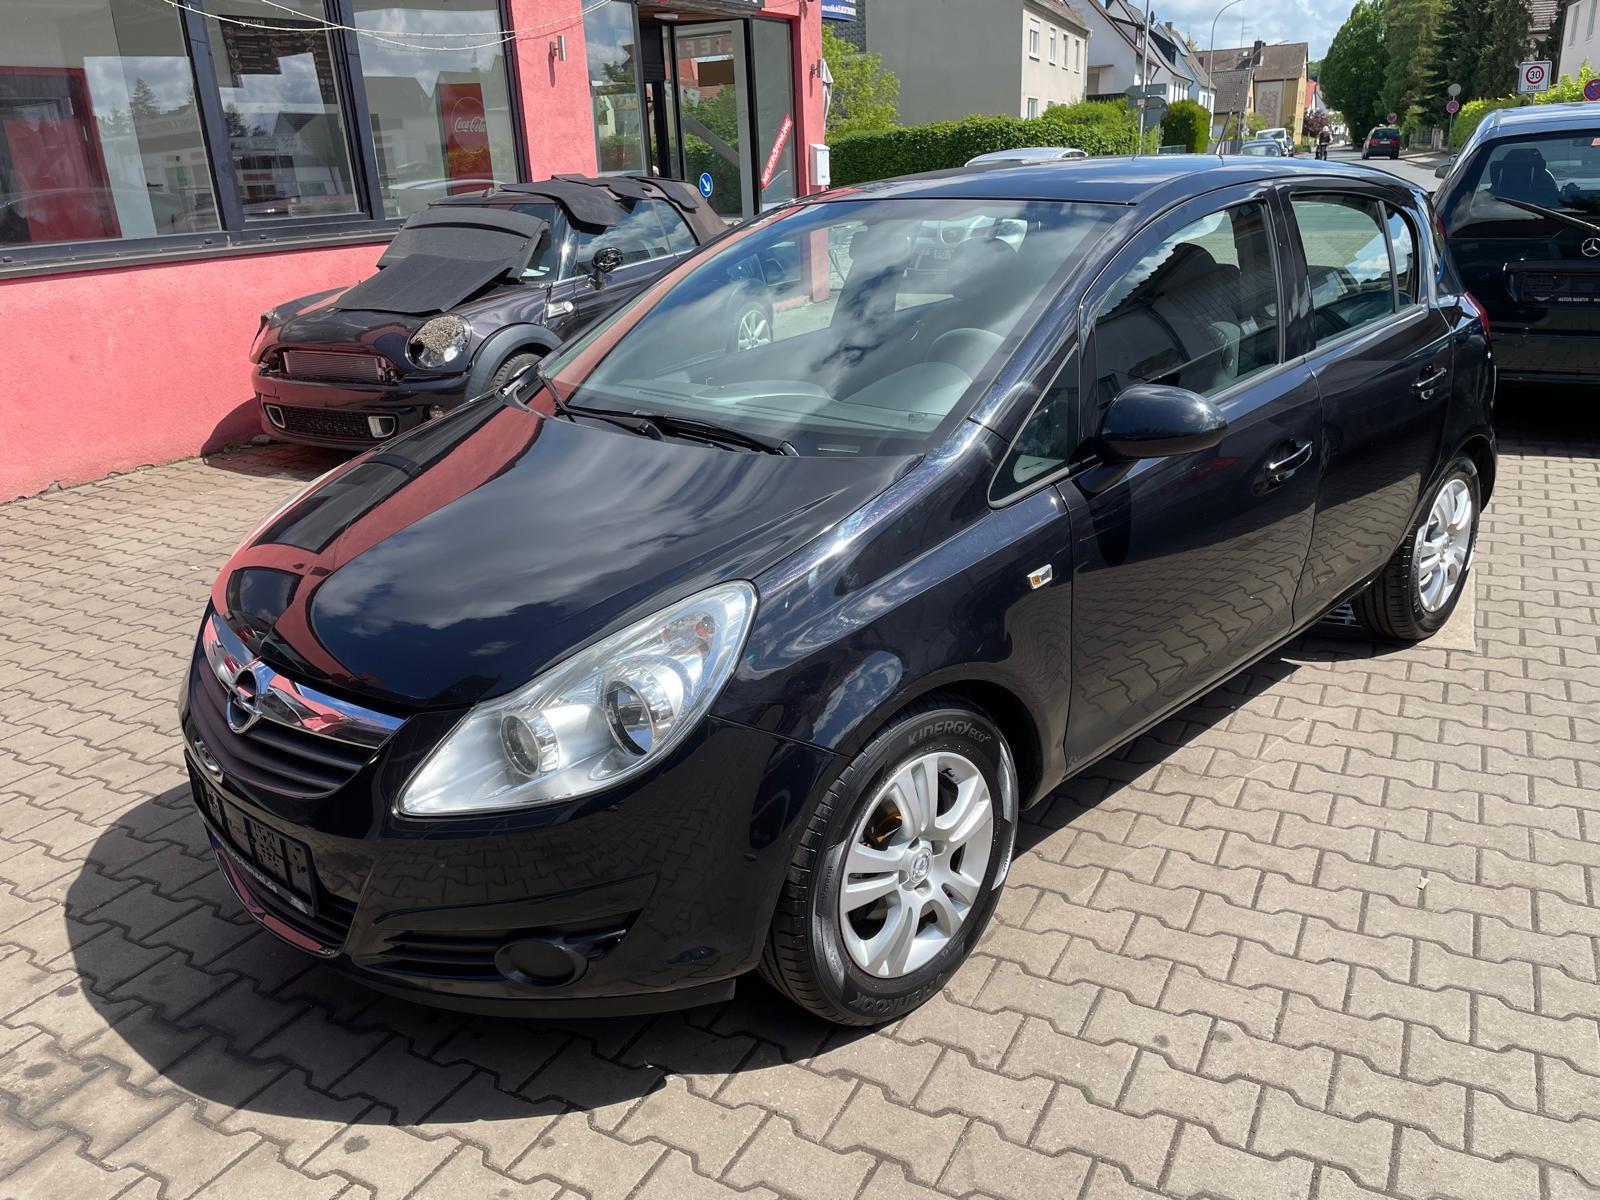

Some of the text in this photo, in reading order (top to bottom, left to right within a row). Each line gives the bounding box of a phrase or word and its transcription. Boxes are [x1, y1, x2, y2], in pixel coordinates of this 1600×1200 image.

[1529, 70, 1541, 80] 30
[762, 118, 791, 185] NEUERÖFFNUNG
[907, 720, 972, 746] KINERGY
